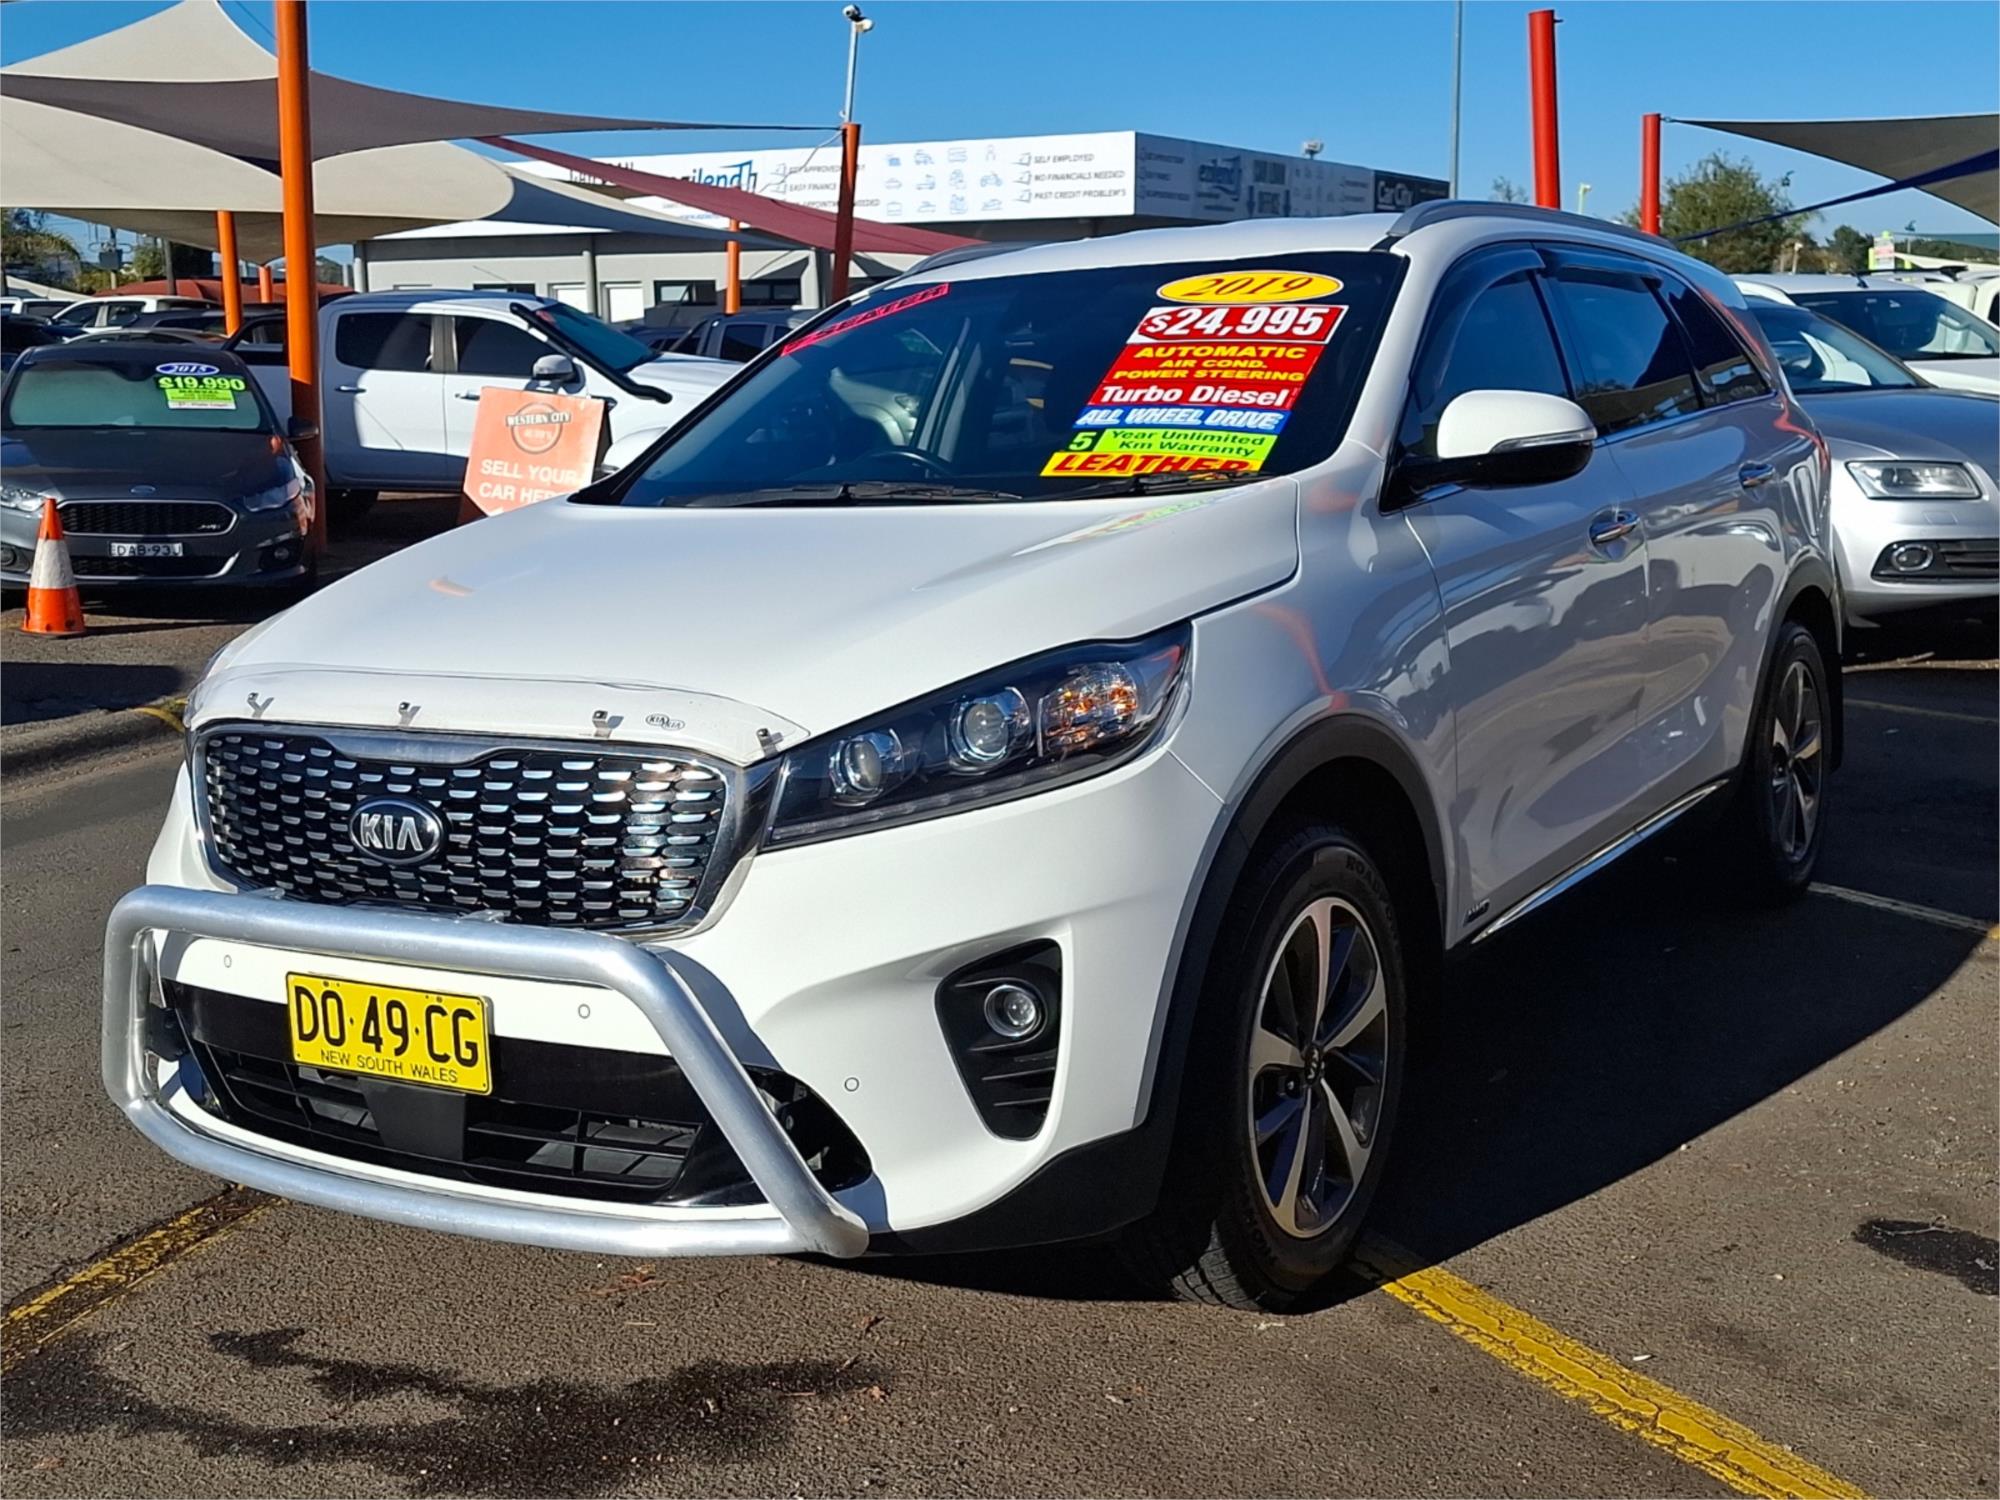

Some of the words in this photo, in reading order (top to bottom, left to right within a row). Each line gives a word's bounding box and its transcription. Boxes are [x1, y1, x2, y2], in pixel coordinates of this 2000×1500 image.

[1034, 155, 1050, 164] SELF
[1052, 153, 1095, 163] EMPLOYED
[1094, 170, 1126, 179] NEEDED
[807, 183, 836, 191] FINANCE
[1054, 190, 1081, 199] CREDIT
[1183, 276, 1314, 297] 2019
[1145, 305, 1331, 336] $24,995
[1133, 346, 1308, 359] AUTOMATIC
[1158, 360, 1197, 368] AIR
[1202, 360, 1268, 369] COND.
[1112, 370, 1190, 380] POWER
[1193, 370, 1306, 382] STEERING
[1099, 384, 1183, 403] Turbo
[1188, 385, 1290, 407] Diesel
[507, 415, 548, 426] WESTERN
[550, 412, 571, 424] CITY
[1075, 408, 1121, 426] ALL
[1124, 408, 1204, 427] WHEEL
[1203, 409, 1285, 430] DRIVE
[1068, 431, 1098, 451] 5
[1110, 431, 1158, 441] Year
[1161, 431, 1267, 446] Unlimited
[1118, 440, 1153, 450] Km
[1159, 441, 1257, 458] Warranty
[480, 458, 523, 480] SELL
[527, 464, 578, 486] YOUR
[479, 482, 516, 502] CAR
[360, 813, 424, 852] KIA
[320, 1049, 351, 1066] NEW
[356, 1053, 404, 1076] SOUTH
[410, 1063, 458, 1083] WALES
